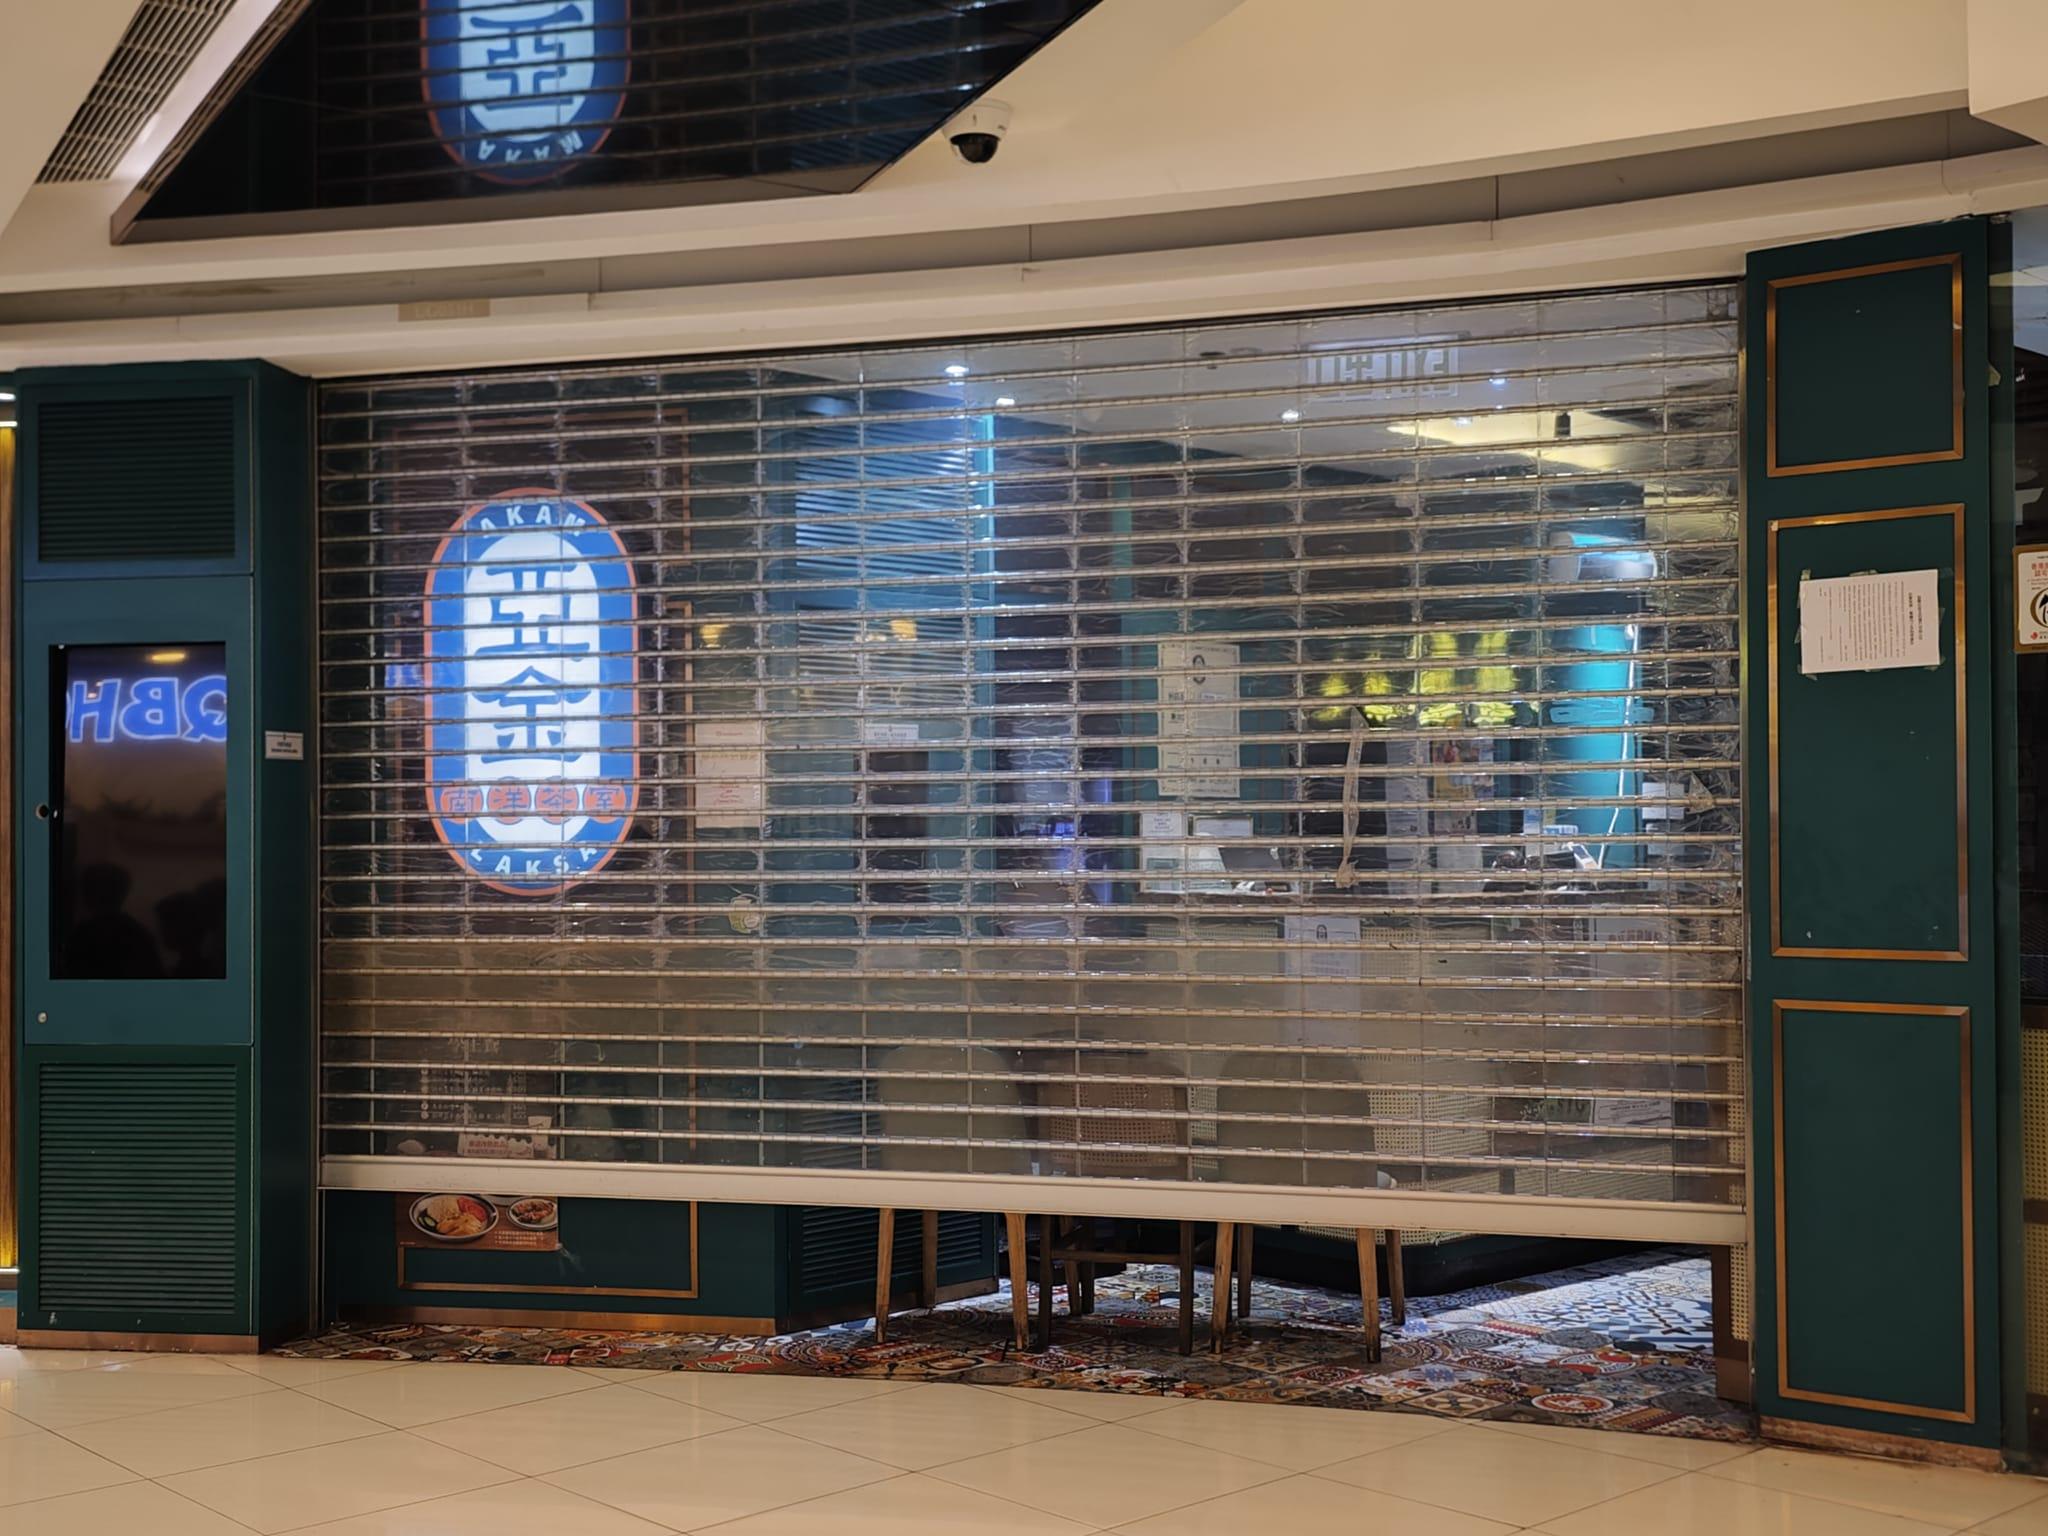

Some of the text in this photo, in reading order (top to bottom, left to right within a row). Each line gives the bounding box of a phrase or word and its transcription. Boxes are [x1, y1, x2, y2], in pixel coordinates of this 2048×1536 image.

[443, 786, 621, 813] 南洋茶室
[470, 840, 598, 878] LAKSA
